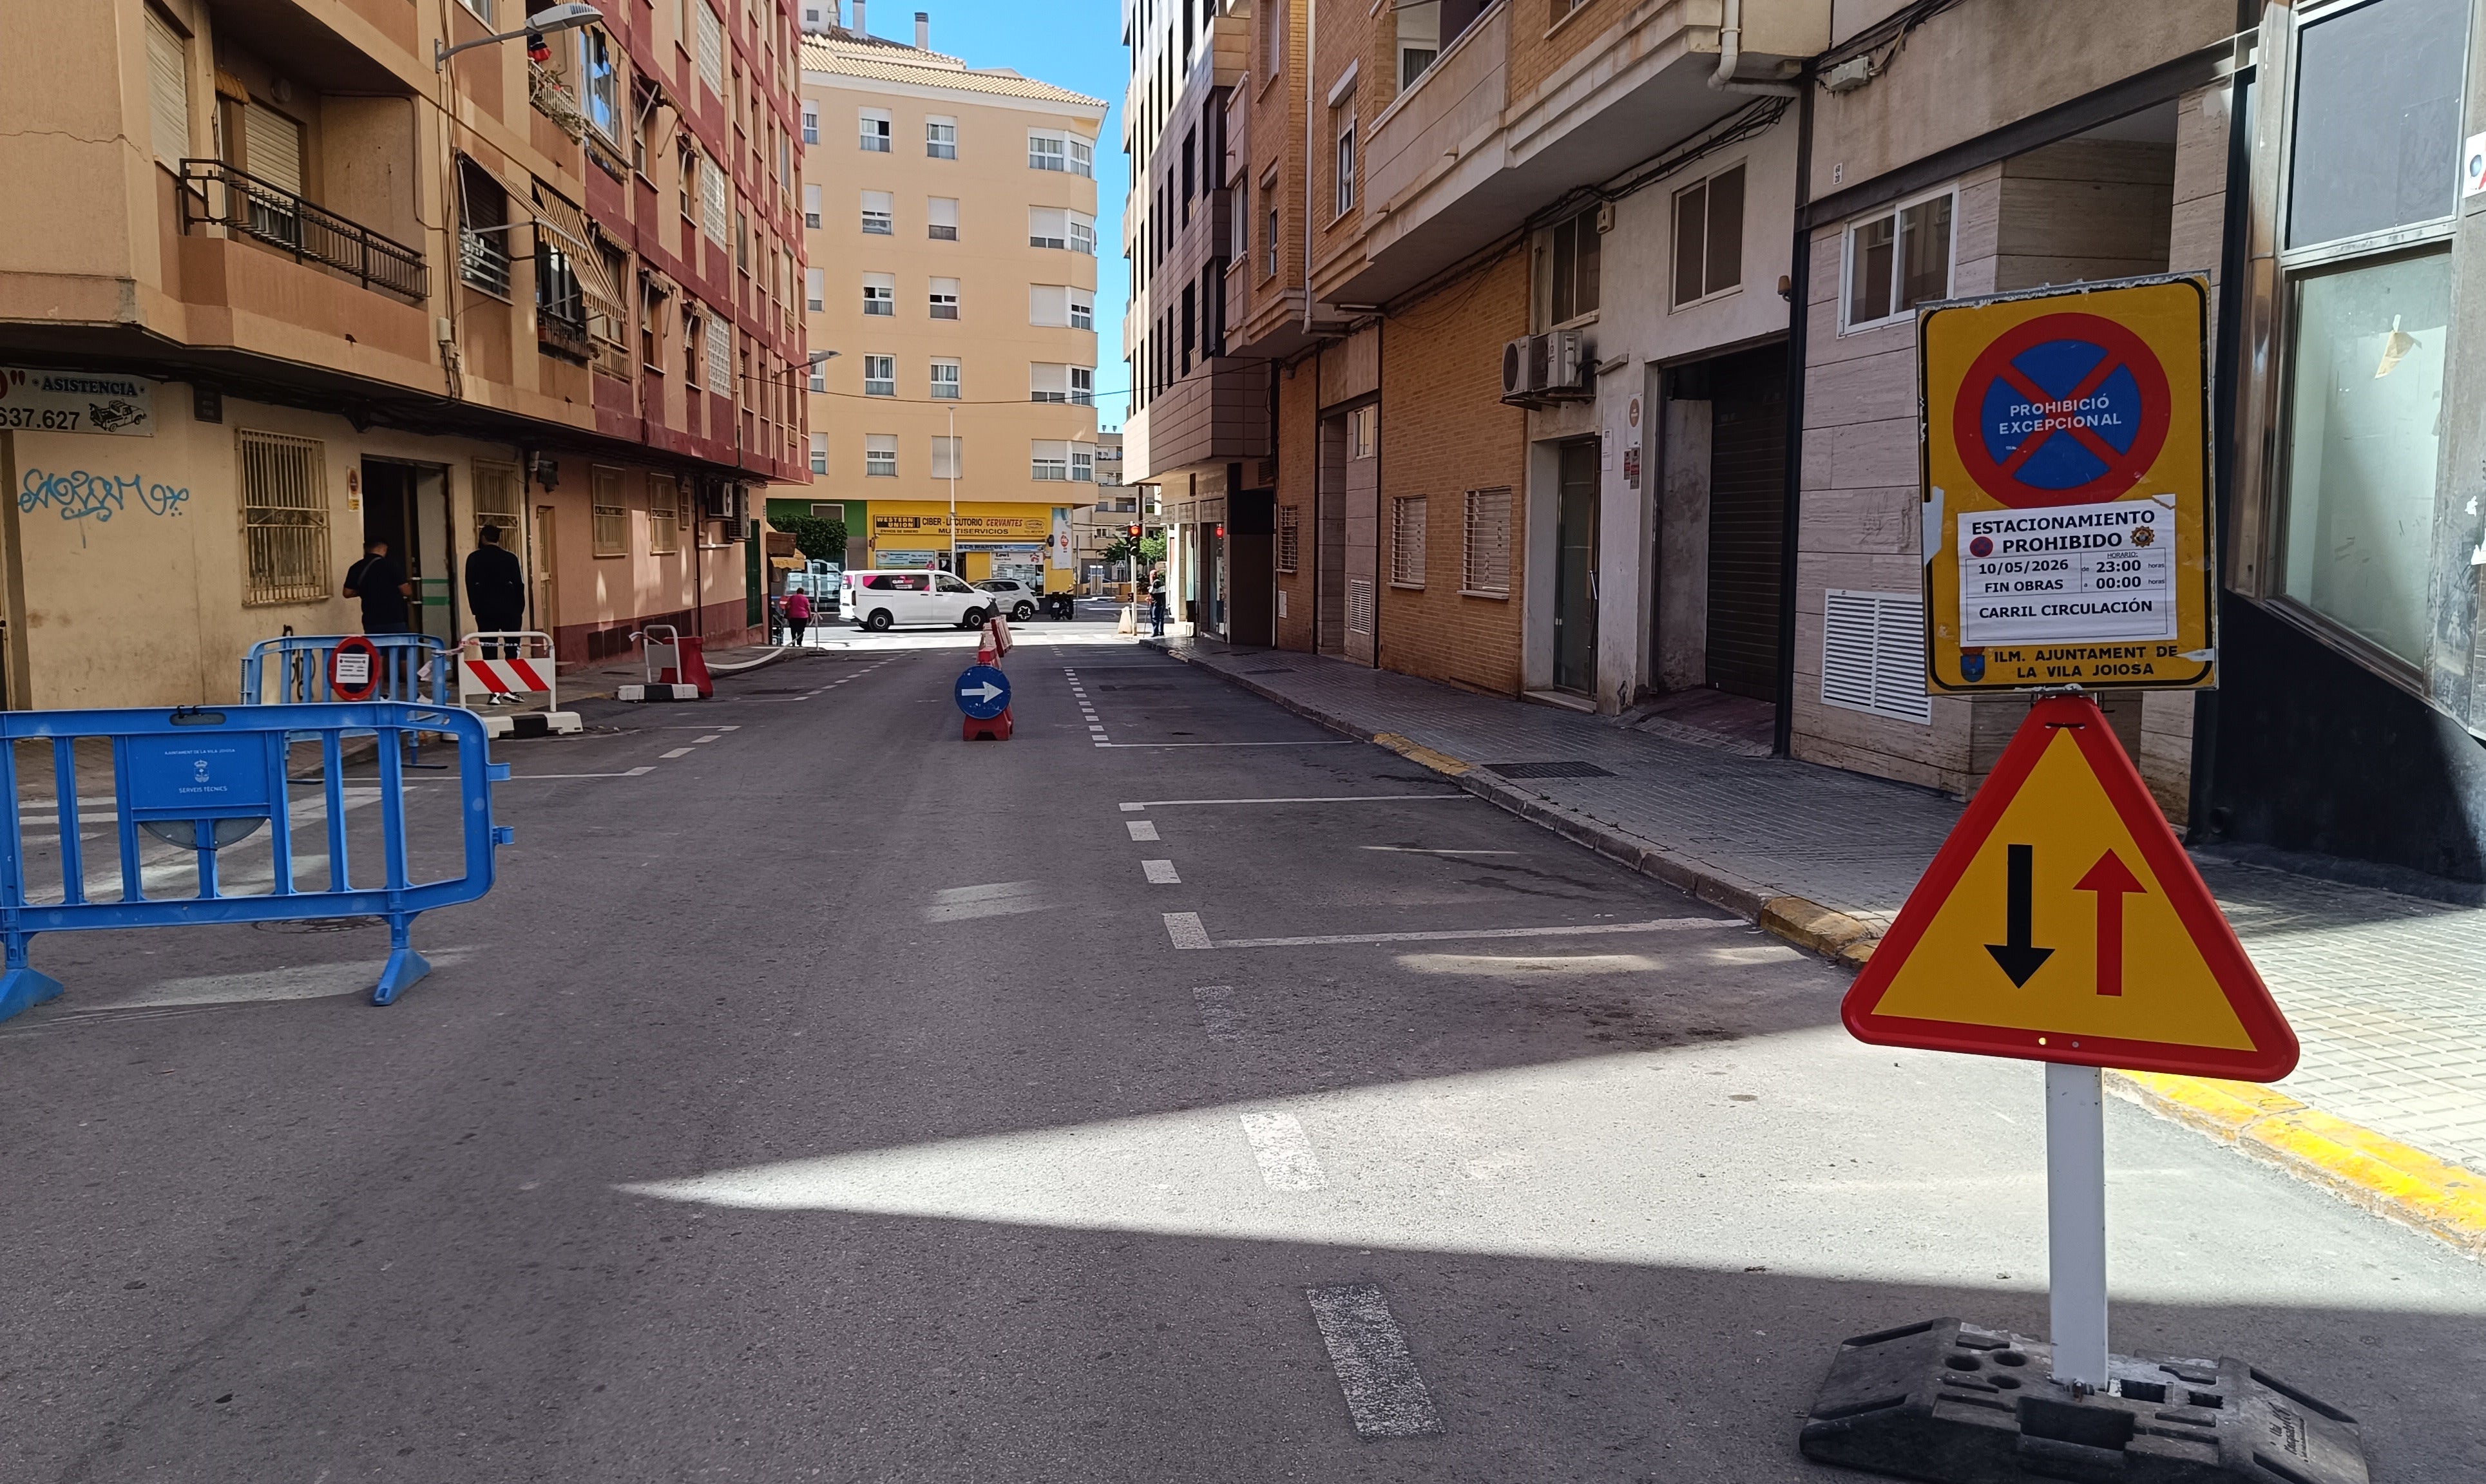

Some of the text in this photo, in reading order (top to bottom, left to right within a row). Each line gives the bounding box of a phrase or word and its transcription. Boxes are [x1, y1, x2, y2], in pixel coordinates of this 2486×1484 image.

[42, 377, 138, 396] ASISTENCIA
[2010, 393, 2109, 417] PROHIBICIÓ
[1999, 413, 2122, 435] EXCEPCIONAL
[923, 517, 941, 526] CIBER
[986, 518, 1023, 527] CERVANTES
[1972, 509, 2155, 535] ESTACIONAMIENTO
[2003, 533, 2122, 553] PROHIBIDO
[1978, 560, 2069, 575] 10/05/2026
[2096, 560, 2141, 573] 23:00
[1985, 579, 2063, 593] FIN OBRAS
[2096, 576, 2141, 589] 00:00
[1979, 597, 2152, 618] CARRIL CIRCULACIÓN
[1994, 645, 2178, 663] ILM. AJUNTAMENT DE
[2017, 663, 2154, 678] LA VILA JOIOSA
